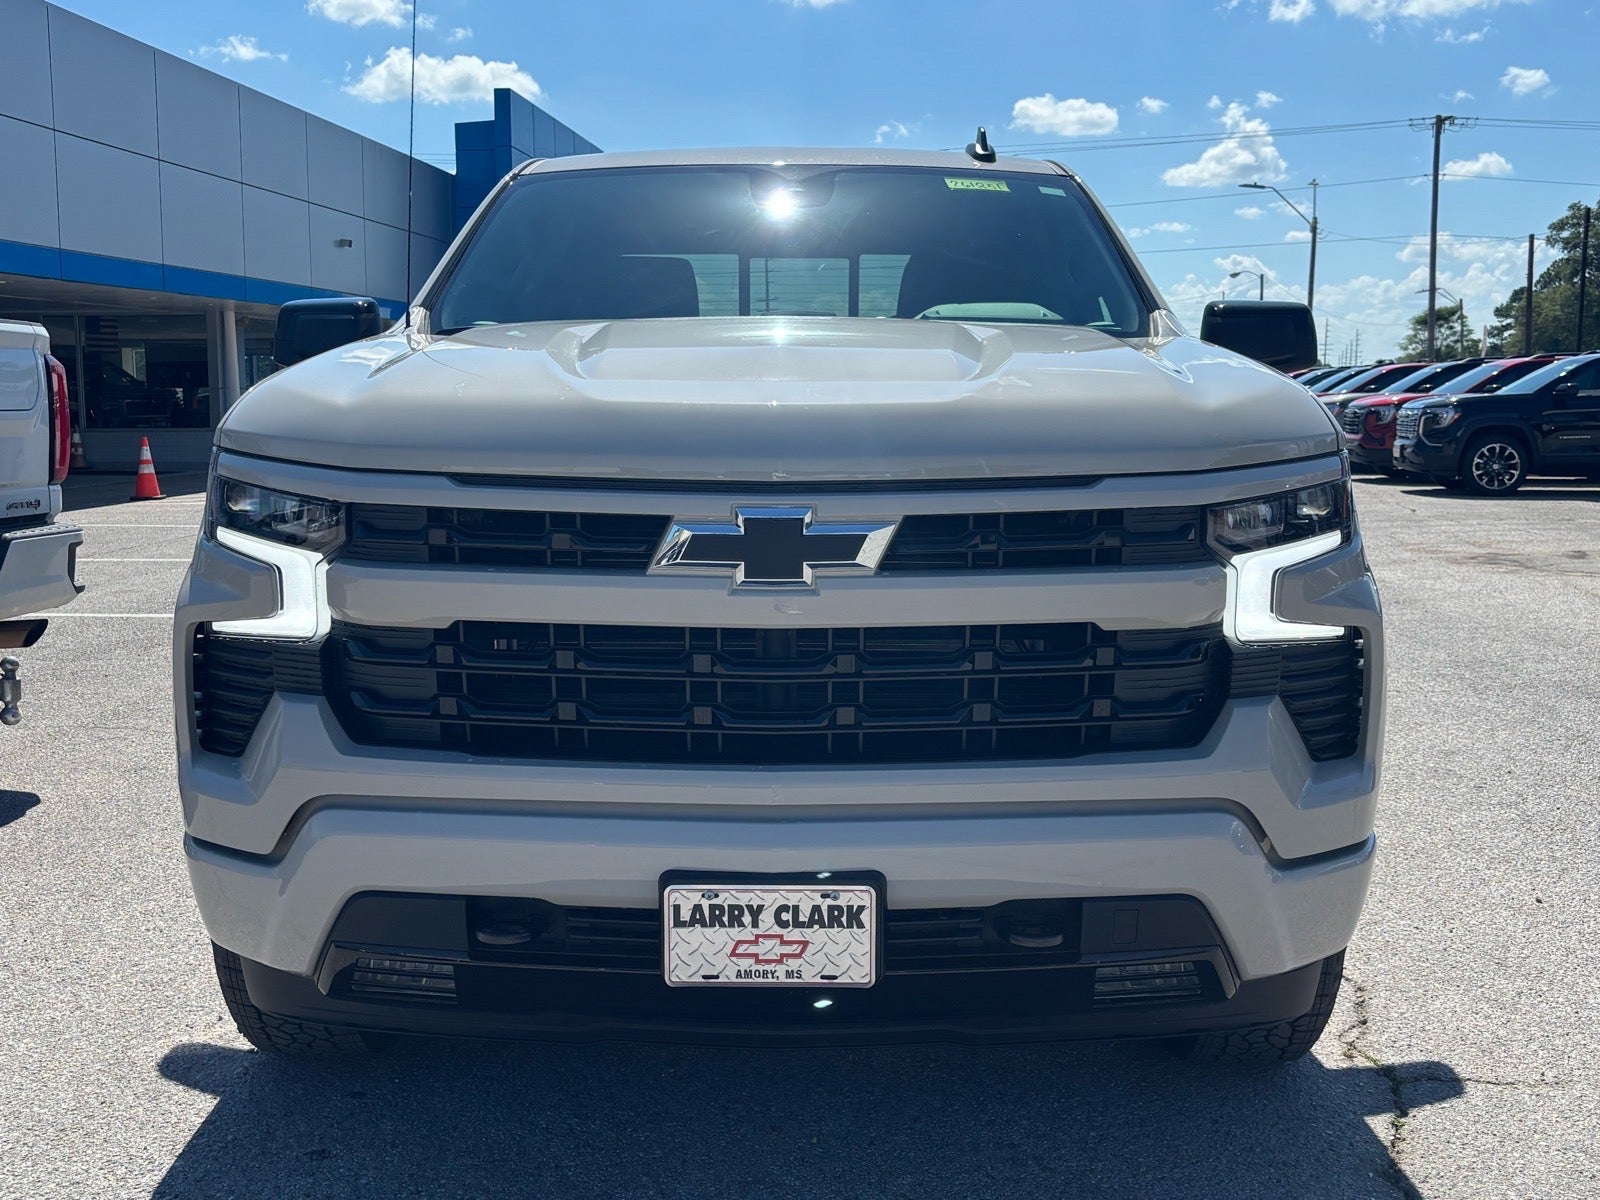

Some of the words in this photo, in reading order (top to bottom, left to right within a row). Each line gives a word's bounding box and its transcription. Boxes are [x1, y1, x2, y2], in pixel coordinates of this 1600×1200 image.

[672, 903, 765, 928] LARRY
[773, 904, 866, 928] CLARK
[735, 969, 780, 981] AMORY,
[785, 970, 803, 979] MS
